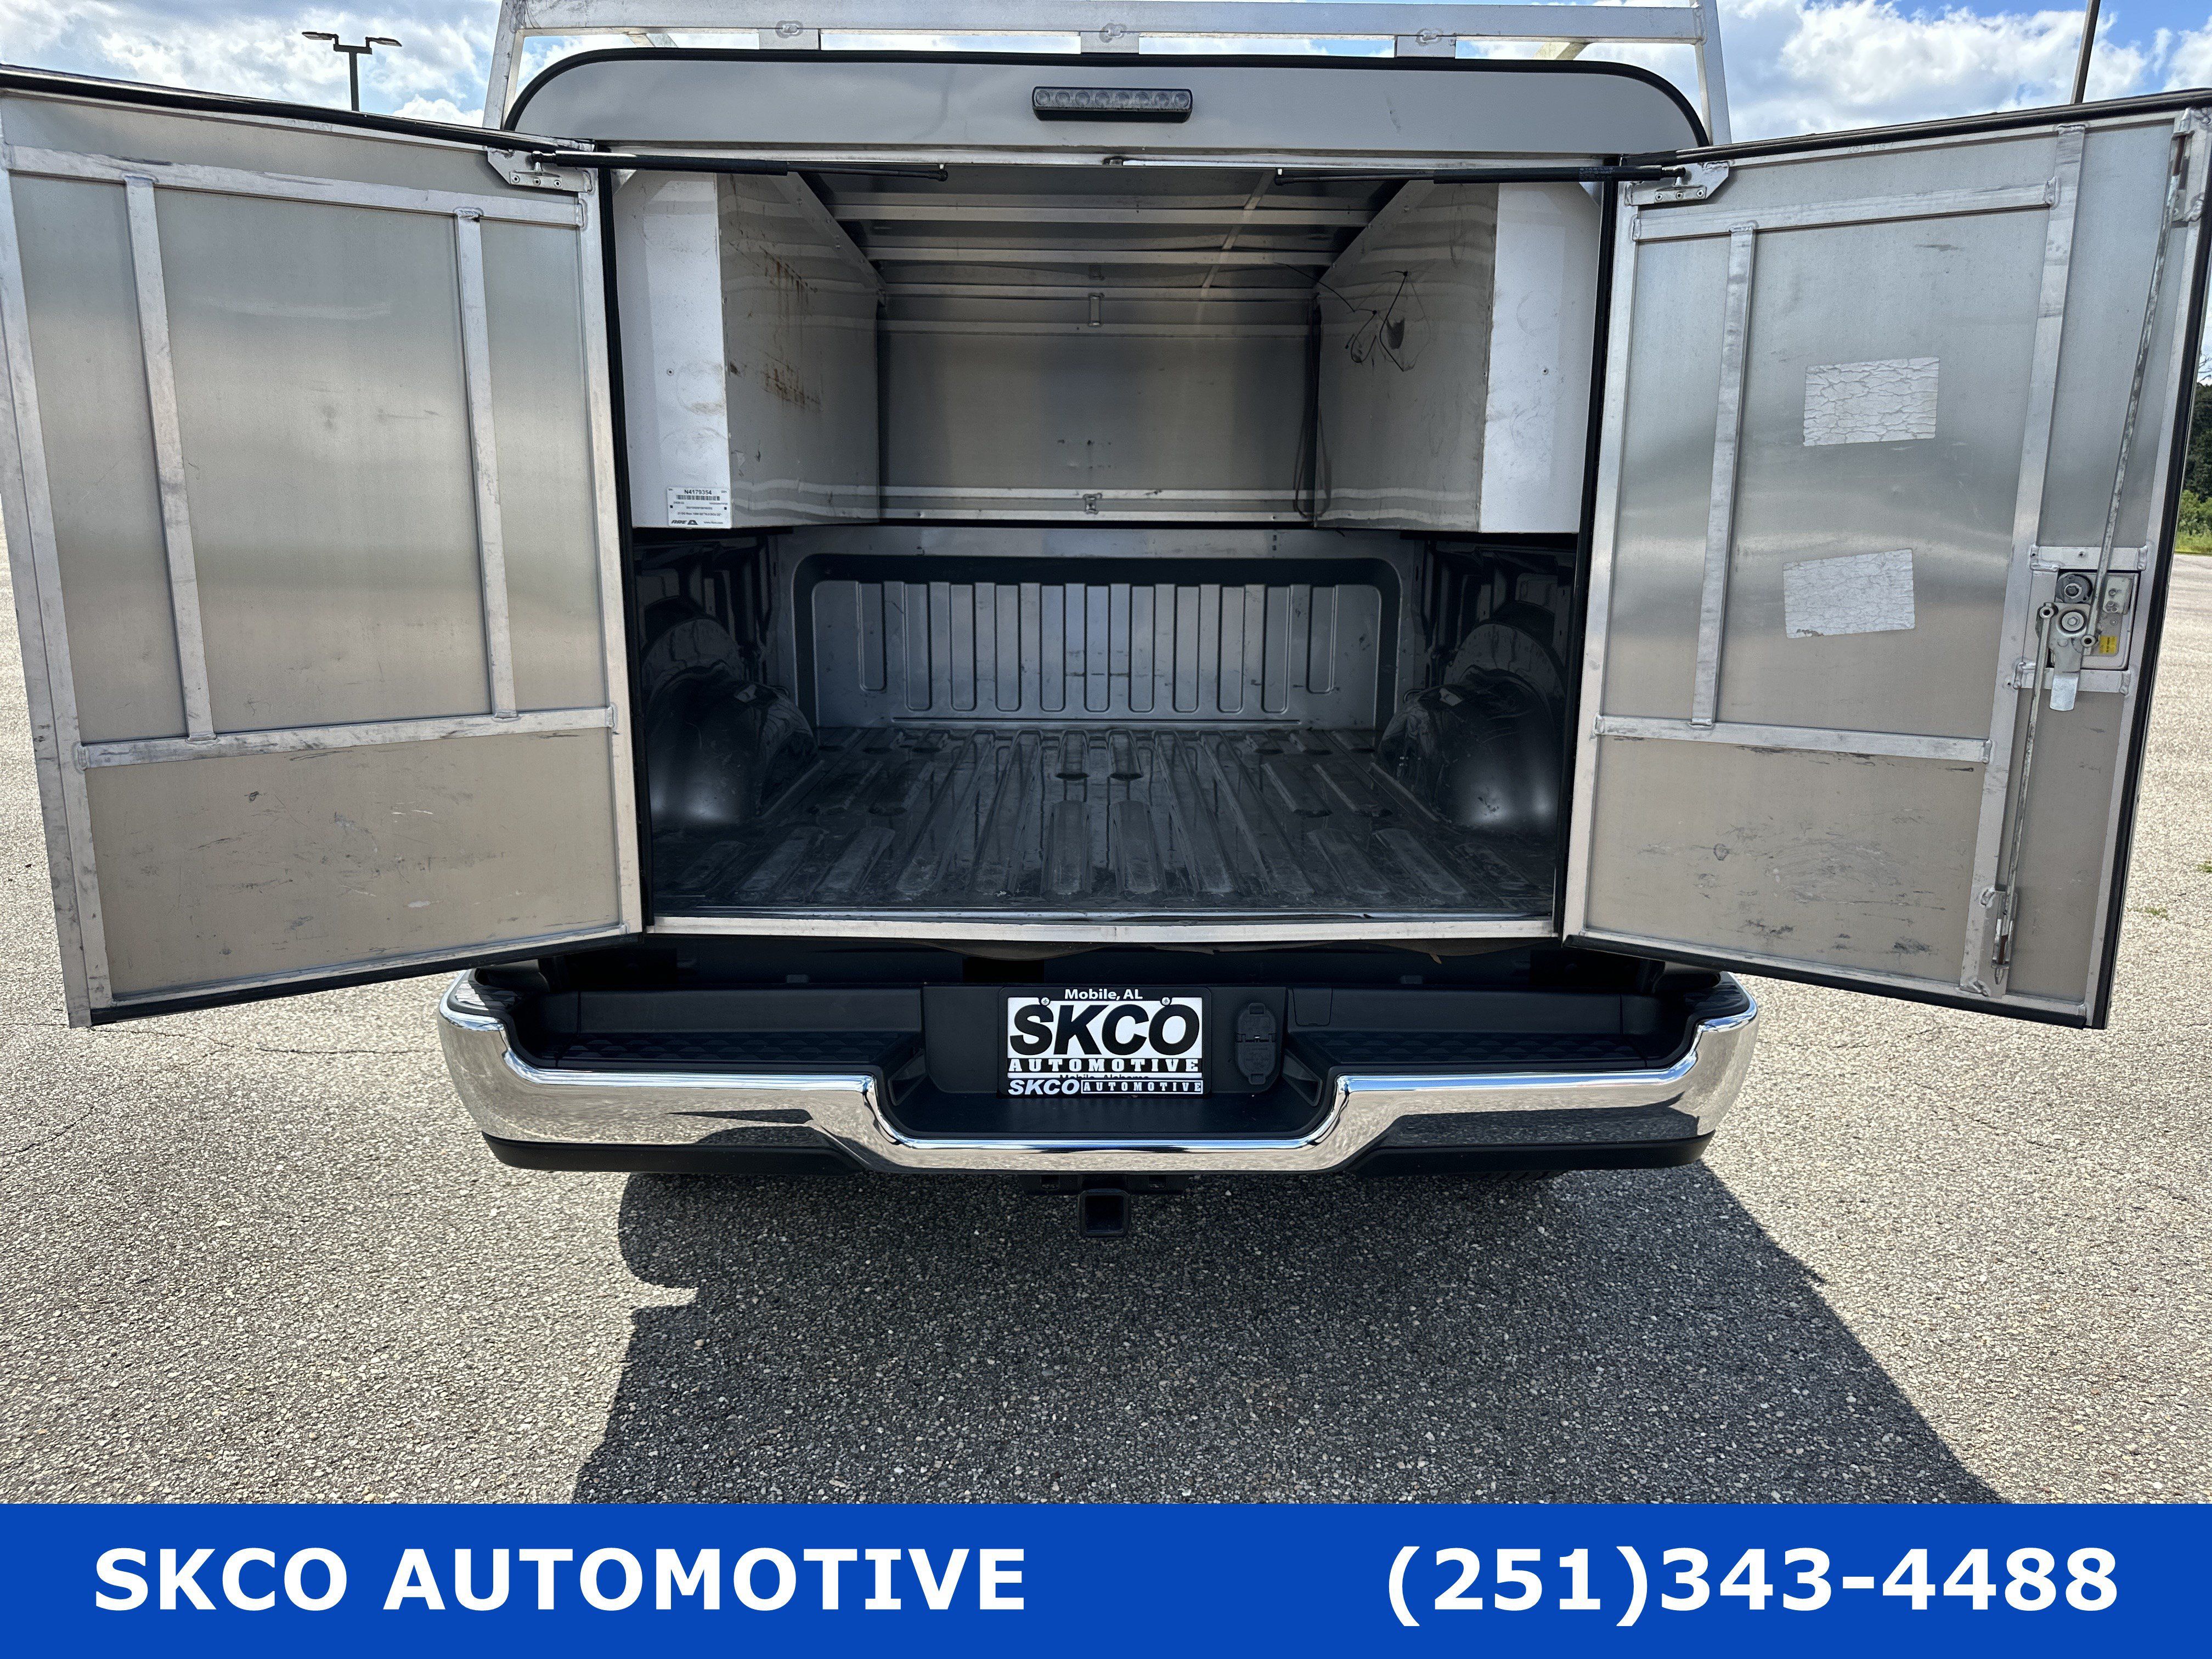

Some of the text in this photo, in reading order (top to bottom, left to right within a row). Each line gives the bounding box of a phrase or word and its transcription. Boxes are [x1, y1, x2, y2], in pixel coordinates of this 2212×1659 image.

[1064, 989, 1143, 1001] Mobile, AL
[1009, 1003, 1200, 1056] SKCO
[1008, 1058, 1199, 1072] AUTOMOTIVE
[1008, 1079, 1201, 1095] SKCO AUTOMOTIVE
